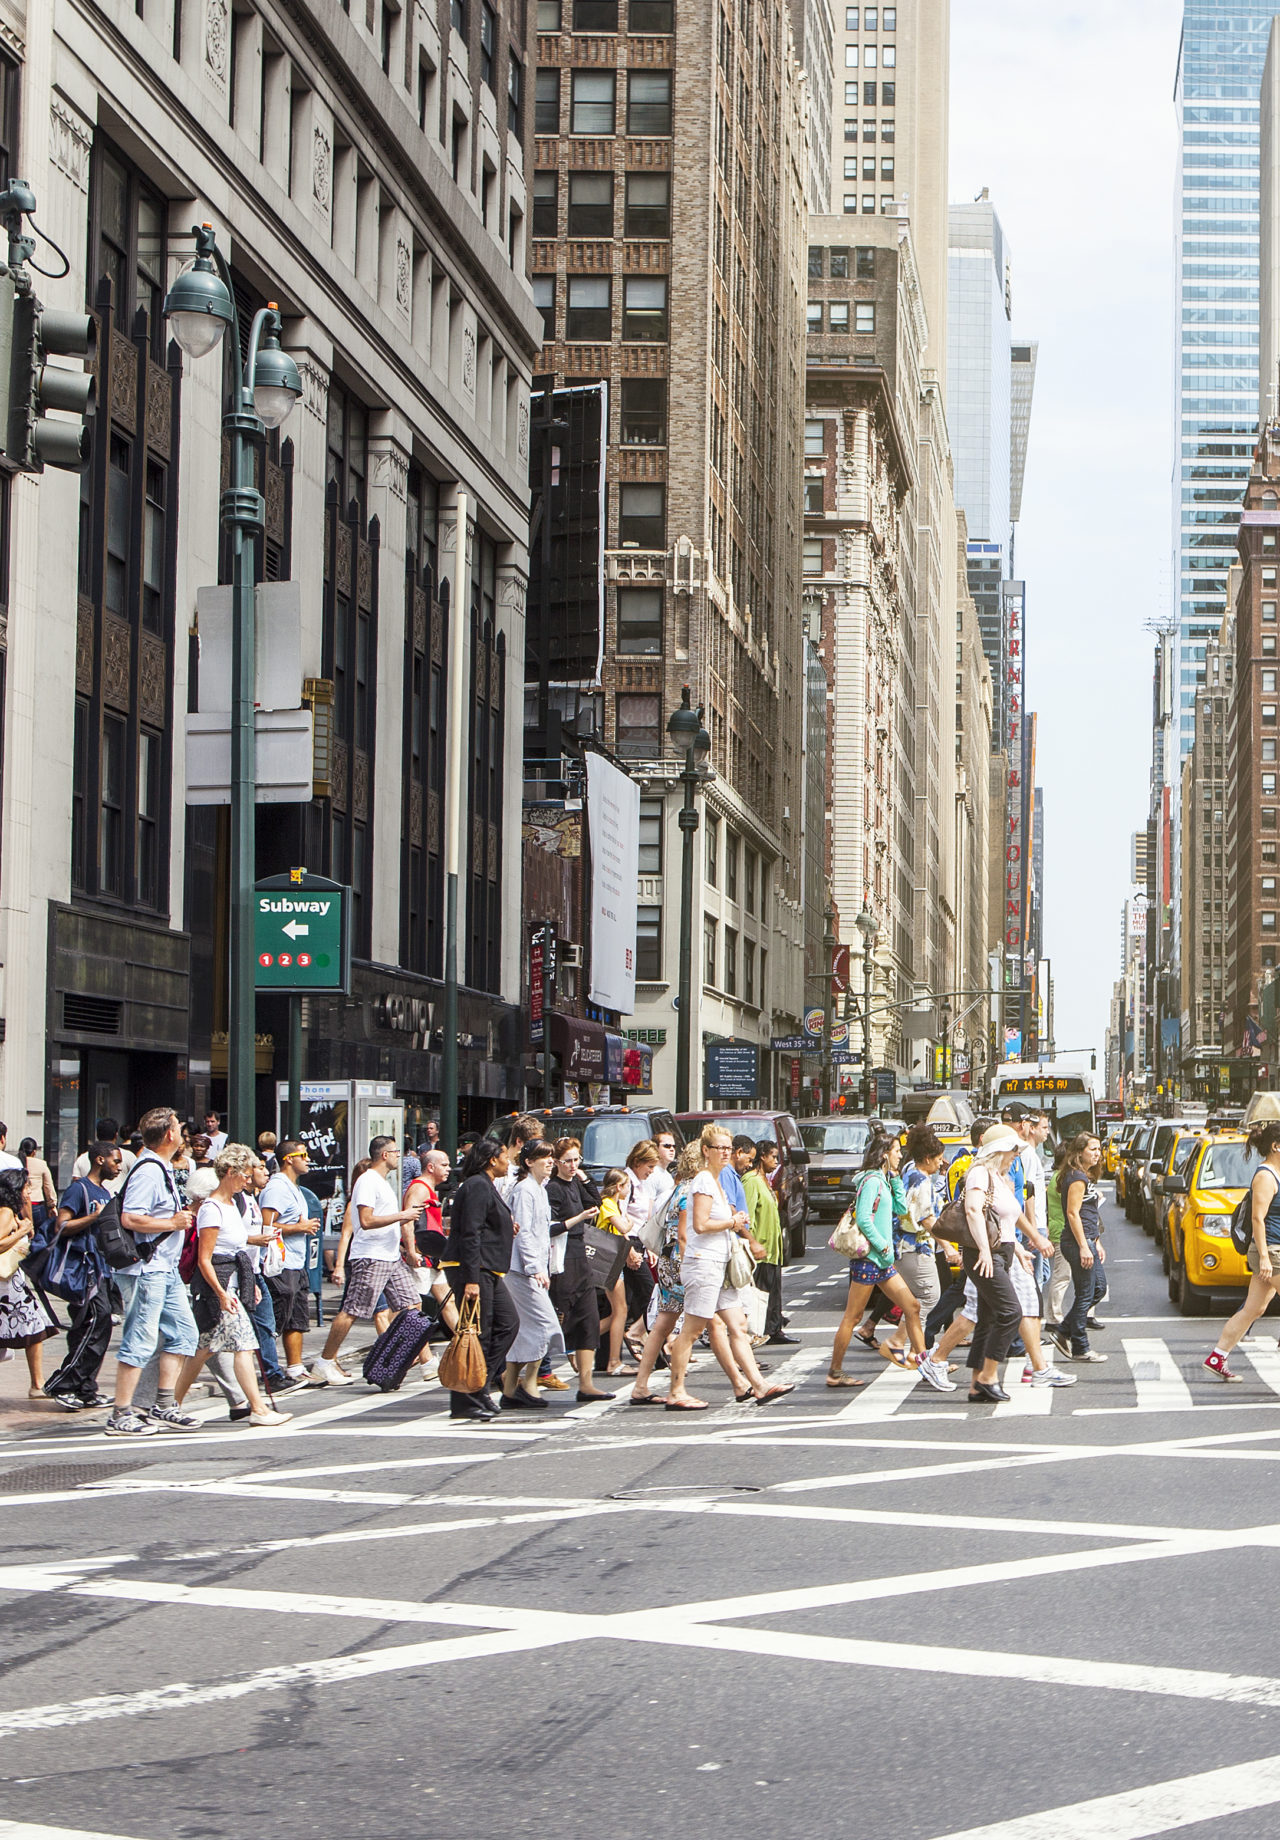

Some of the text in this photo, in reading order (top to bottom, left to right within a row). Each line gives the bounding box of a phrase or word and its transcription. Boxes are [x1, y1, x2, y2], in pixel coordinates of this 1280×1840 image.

[1006, 611, 1021, 945] ERNST & YOUNG
[260, 898, 330, 916] Subway
[620, 1028, 667, 1044] OFFEE
[793, 1040, 806, 1048] 35th
[807, 1040, 815, 1048] St
[1006, 1080, 1068, 1091] M7 14 ST-6 AV
[308, 1128, 336, 1158] up!
